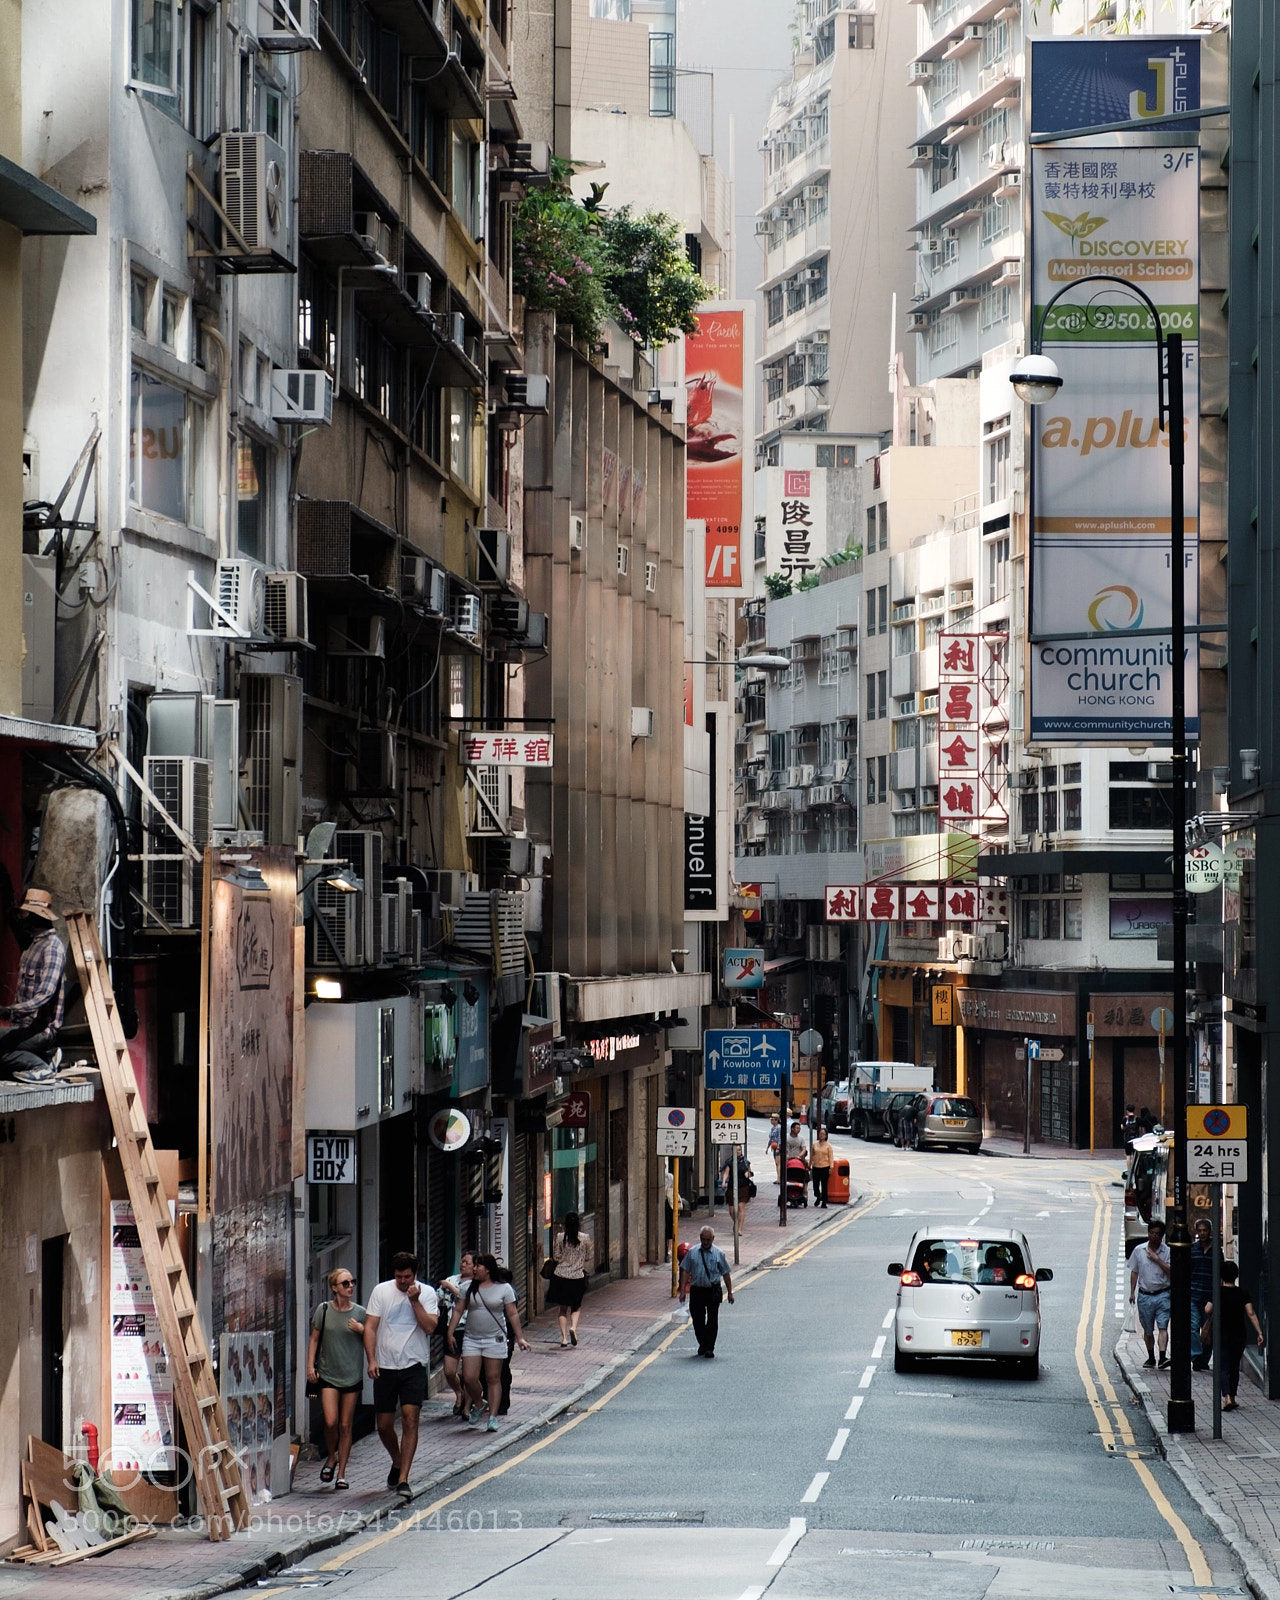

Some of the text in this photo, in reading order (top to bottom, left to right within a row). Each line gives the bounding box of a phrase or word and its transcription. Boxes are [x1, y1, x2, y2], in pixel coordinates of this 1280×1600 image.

[1044, 162, 1118, 180] 香港國際
[1163, 152, 1194, 173] 3/F
[1044, 182, 1157, 200] 蒙特梭利學校
[1079, 239, 1189, 257] DISCOVERY
[1052, 262, 1189, 276] Montessori School
[1043, 312, 1086, 329] Call:
[1163, 352, 1194, 369] 2F
[1041, 409, 1190, 456] a.plus
[1074, 521, 1156, 531] www.aplushk.com
[779, 500, 816, 582] 俊昌行
[707, 544, 738, 578] /F
[1165, 553, 1193, 569] 1F
[1067, 667, 1161, 691] church
[1078, 695, 1155, 705] HONG KONG
[942, 639, 977, 815] 利昌金鋪
[1044, 719, 1187, 731] www.communitychurch.
[689, 814, 712, 878] anuel
[829, 888, 977, 919] 利昌金鋪
[935, 990, 949, 1022] 樓上
[723, 1059, 786, 1069] Kowloon (W)
[714, 1122, 741, 1130] 24 hrs
[681, 1131, 688, 1141] 7
[313, 1138, 350, 1160] GYM
[681, 1145, 688, 1154] 7
[1193, 1145, 1240, 1157] 24 hrs
[313, 1159, 347, 1181] BOX
[1198, 1161, 1235, 1178] 全日
[494, 1211, 504, 1256] JEWELLERY
